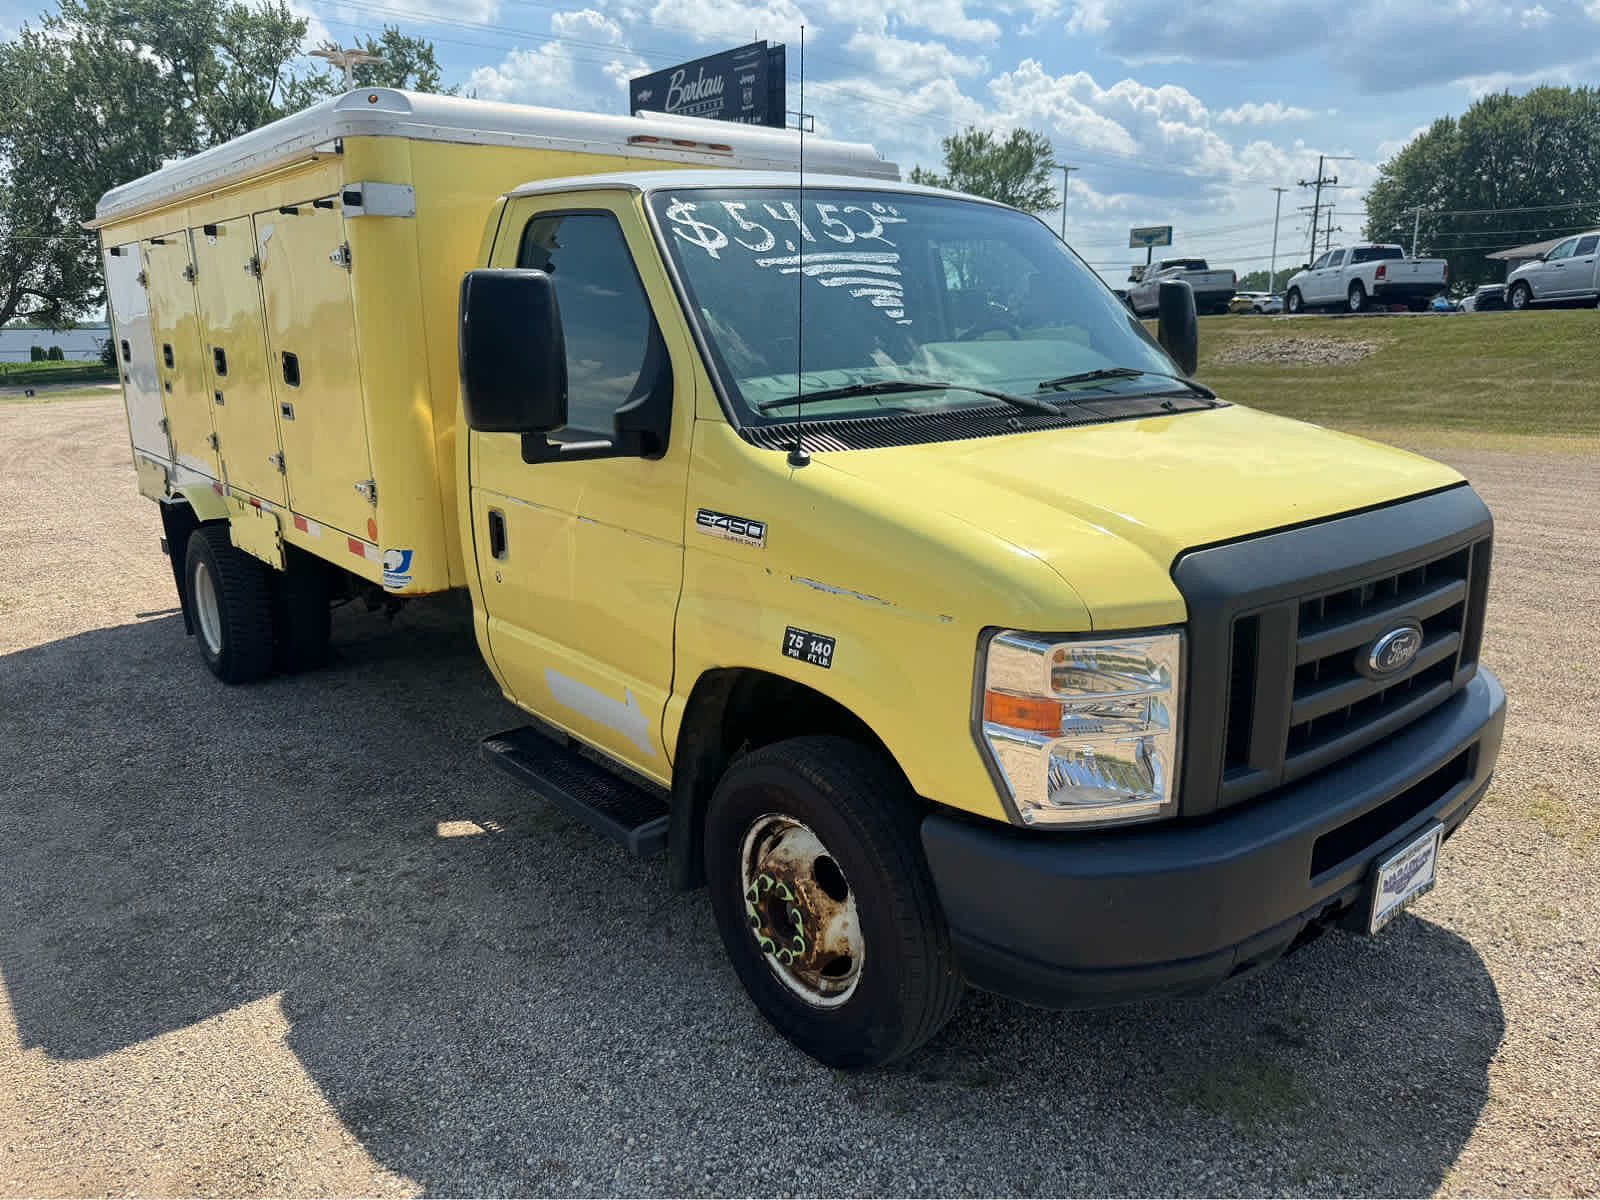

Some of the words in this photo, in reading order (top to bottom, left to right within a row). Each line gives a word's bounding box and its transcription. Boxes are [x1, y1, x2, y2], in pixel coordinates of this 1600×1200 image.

[665, 66, 725, 112] Barkau
[788, 633, 805, 649] 75
[810, 640, 832, 657] 140
[788, 647, 800, 657] PSI
[1387, 635, 1417, 665] Ford
